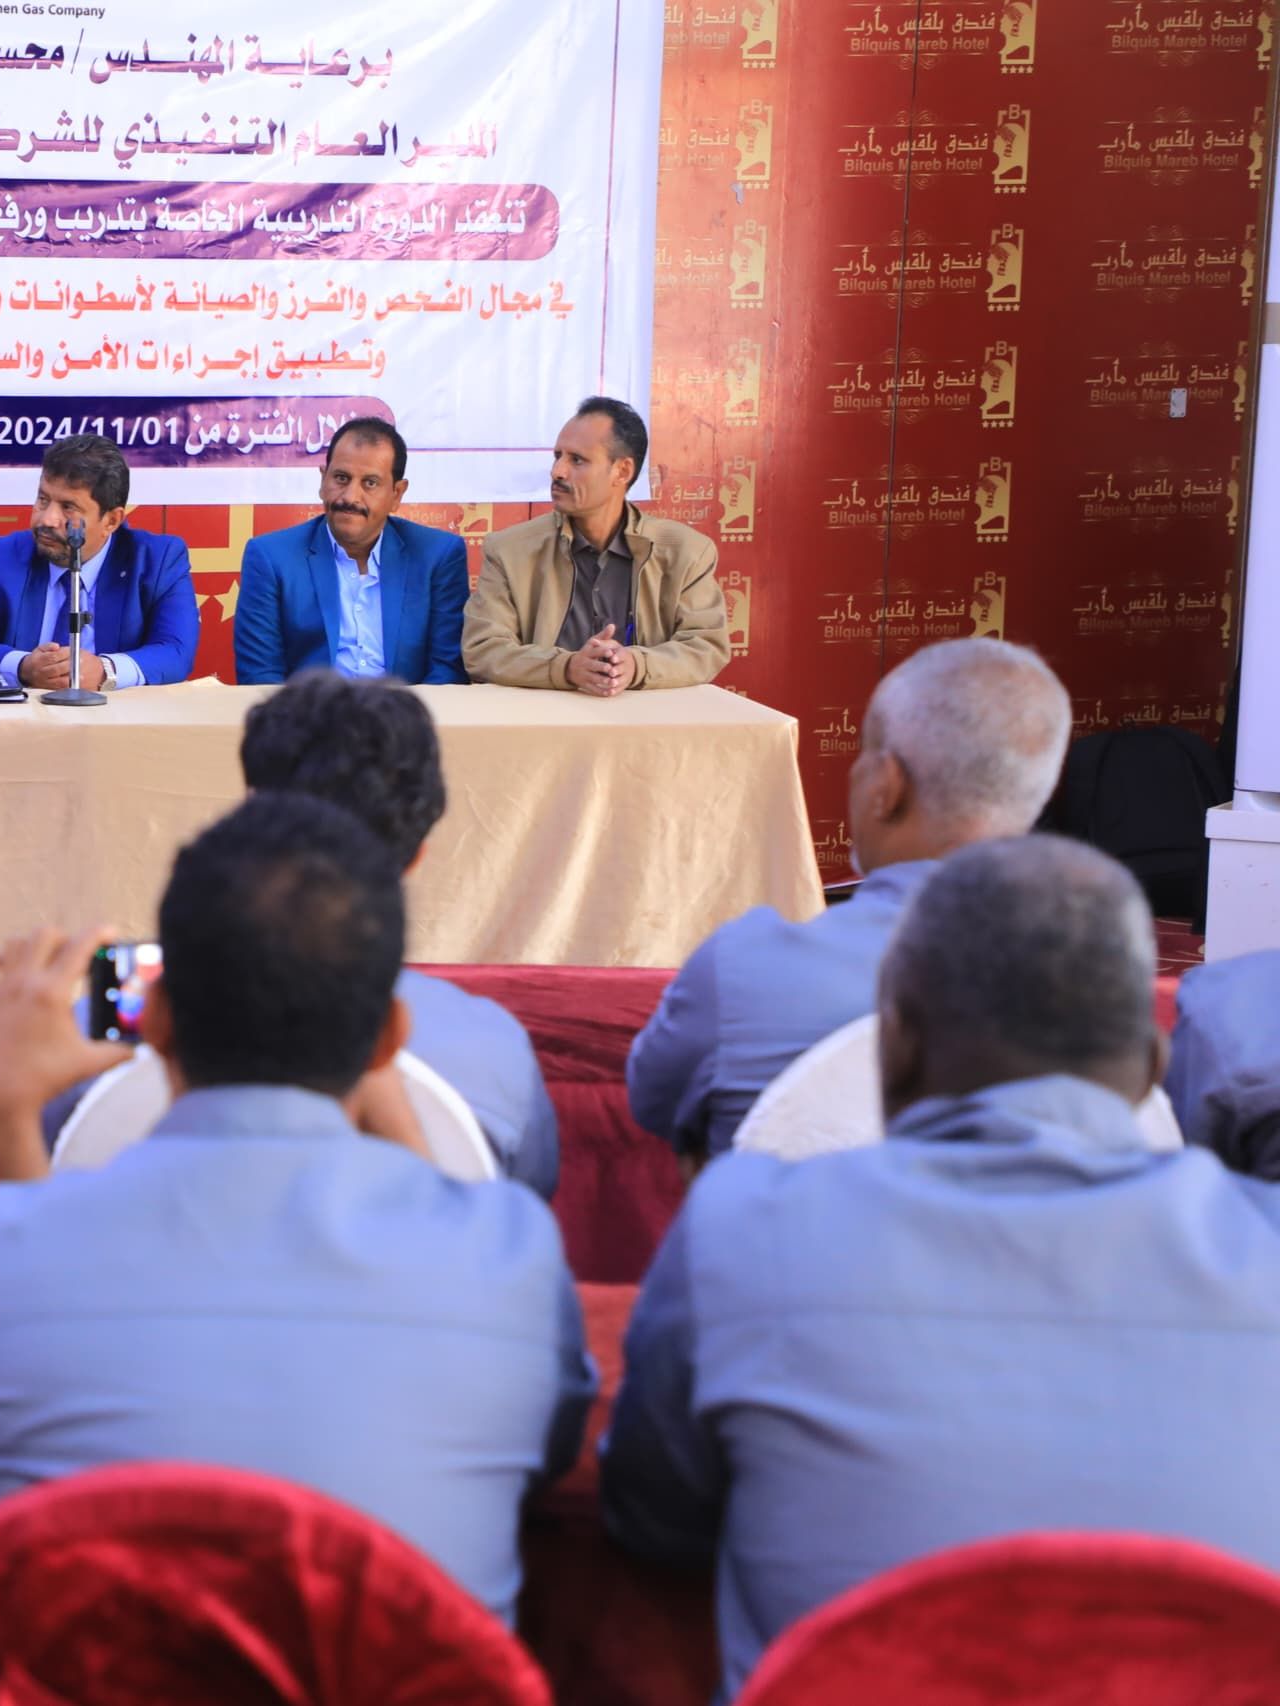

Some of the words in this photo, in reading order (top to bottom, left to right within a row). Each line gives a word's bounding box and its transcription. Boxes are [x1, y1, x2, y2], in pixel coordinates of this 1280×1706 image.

[22, 4, 44, 15] Gas
[48, 4, 105, 19] Company
[692, 6, 736, 26] فندق
[843, 6, 889, 36] مأرب
[897, 10, 944, 35] بلقيس
[951, 12, 996, 33] فندق
[1105, 3, 1149, 33] مأرب
[1157, 9, 1203, 32] بلقيس
[1210, 9, 1254, 30] فندق
[850, 38, 900, 54] Bilquis
[905, 38, 948, 51] Mareb
[952, 37, 990, 50] Hotel
[1112, 35, 1159, 50] Bilquis
[1164, 34, 1206, 48] Mareb
[1211, 34, 1248, 47] Hotel
[245, 34, 393, 89] برعاية
[114, 111, 286, 170] التنفيذي
[293, 119, 398, 166] العام
[687, 128, 731, 148] فندق
[837, 128, 882, 156] مأرب
[890, 132, 937, 156] بلقيس
[945, 133, 988, 154] فندق
[1097, 123, 1141, 152] مأرب
[1149, 128, 1195, 152] بلقيس
[1202, 129, 1245, 150] فندق
[844, 159, 893, 175] Bilquis
[899, 159, 942, 171] Mareb
[946, 158, 983, 170] Hotel
[1104, 155, 1152, 170] Bilquis
[1156, 154, 1198, 167] Mareb
[1203, 153, 1239, 166] Hotel
[55, 197, 146, 242] بتدريب
[155, 197, 244, 233] الخاصة
[253, 198, 366, 243] التدريبية
[374, 200, 446, 241] الدورة
[832, 247, 876, 276] مأرب
[884, 251, 931, 275] بلقيس
[939, 252, 982, 272] فندق
[1091, 241, 1134, 270] مأرب
[1142, 246, 1187, 270] بلقيس
[1194, 246, 1236, 267] فندق
[9, 274, 156, 319] لأسطوانات
[839, 278, 888, 294] Bilquis
[893, 277, 935, 290] Mareb
[940, 276, 976, 288] Hotel
[163, 280, 279, 319] والصيانة
[282, 280, 367, 320] والفرز
[373, 279, 472, 321] الفحص
[479, 281, 543, 320] مجال
[549, 281, 574, 320] في
[51, 334, 129, 379] الأمن
[266, 338, 387, 380] وتطبيق
[827, 364, 871, 393] مأرب
[879, 369, 925, 392] بلقيس
[933, 369, 976, 389] فندق
[833, 395, 882, 411] Bilquis
[887, 394, 930, 407] Mareb
[934, 393, 971, 405] Hotel
[185, 415, 220, 456] من
[228, 410, 303, 454] الفترة
[822, 480, 866, 509] مأرب
[874, 485, 920, 508] بلقيس
[928, 484, 971, 506] فندق
[829, 511, 878, 526] Bilquis
[882, 510, 925, 523] Mareb
[929, 509, 965, 521] Hotel
[818, 595, 861, 623] مأرب
[870, 600, 915, 622] بلقيس
[923, 599, 965, 619] فندق
[824, 625, 873, 640] Bilquis
[878, 624, 920, 637] Mareb
[924, 623, 960, 636] Hotel
[813, 707, 857, 736] مأرب
